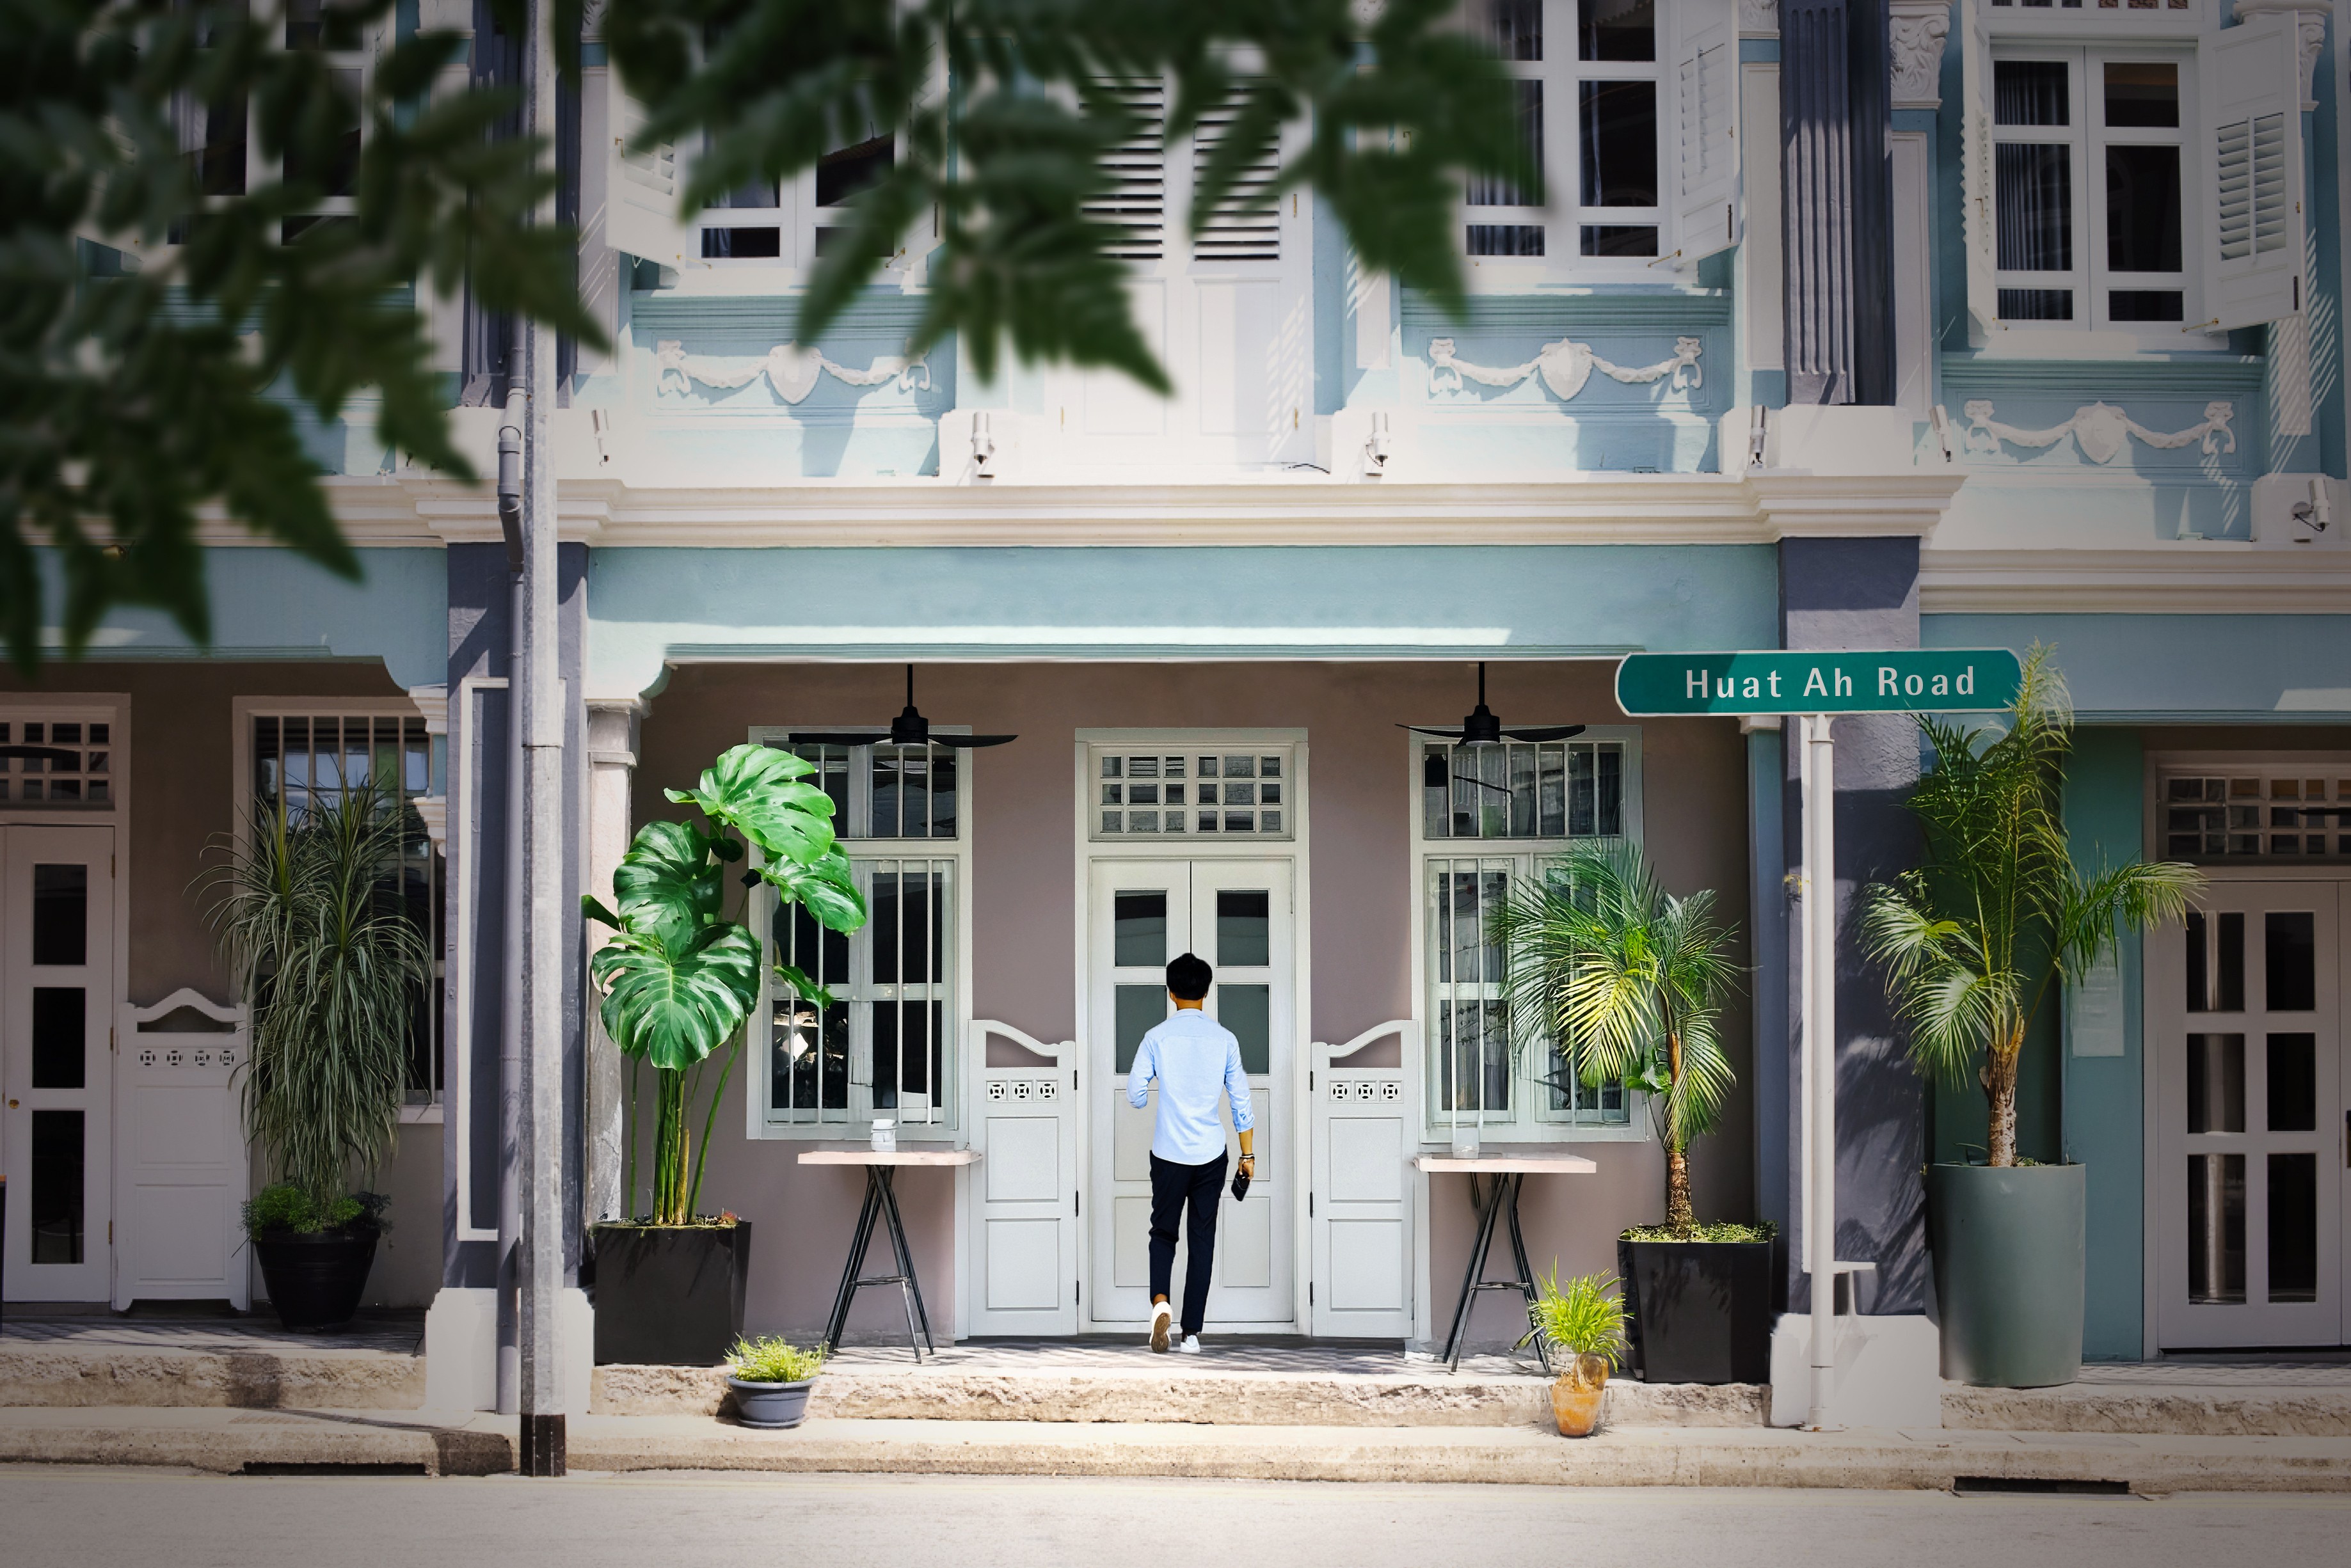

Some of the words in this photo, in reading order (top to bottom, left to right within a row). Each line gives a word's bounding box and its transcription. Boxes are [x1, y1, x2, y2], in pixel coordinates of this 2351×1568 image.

[1686, 669, 1781, 699] Huat
[1803, 667, 1852, 697] Ah
[1878, 666, 1974, 696] Road
